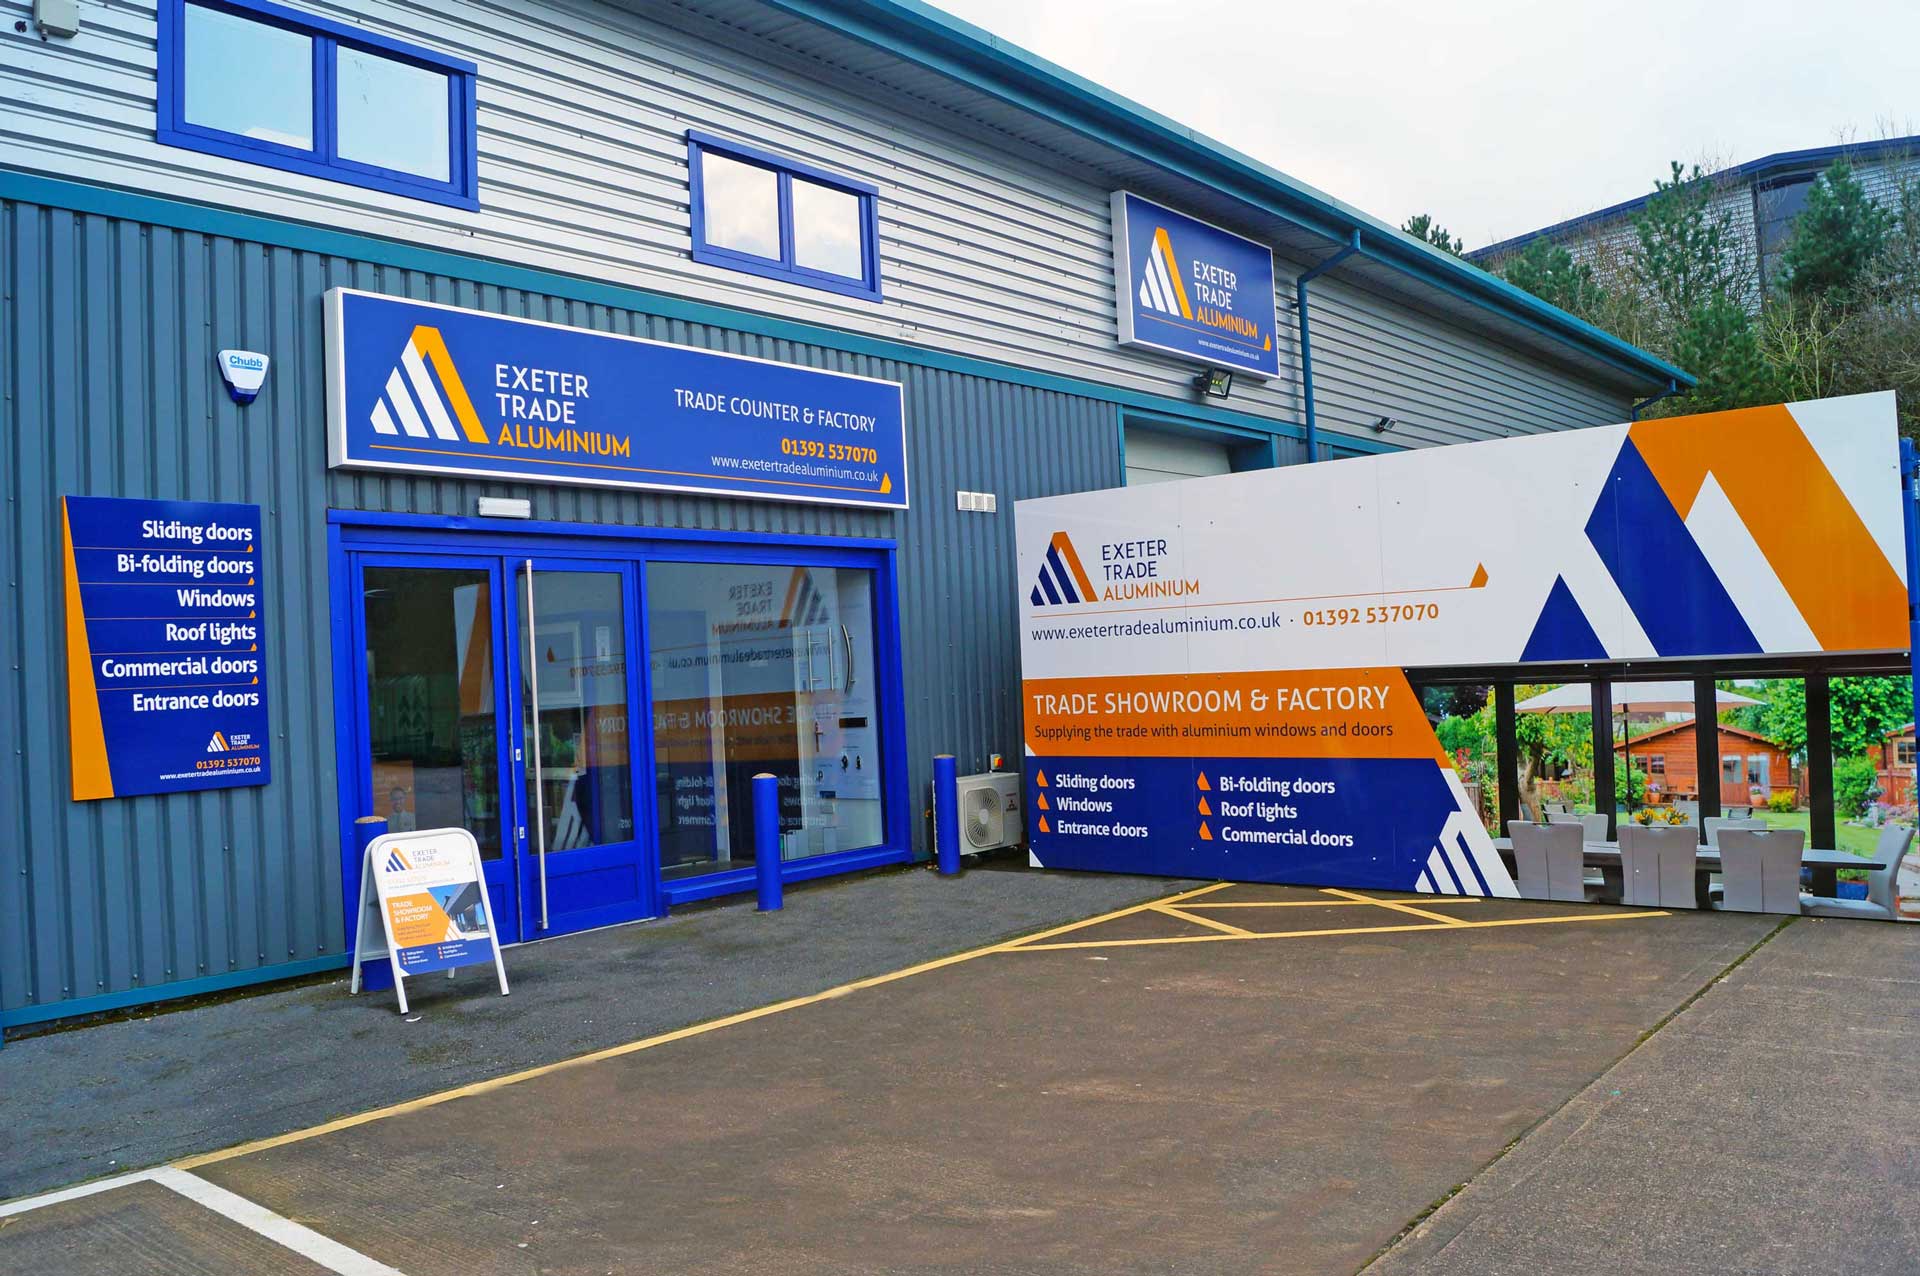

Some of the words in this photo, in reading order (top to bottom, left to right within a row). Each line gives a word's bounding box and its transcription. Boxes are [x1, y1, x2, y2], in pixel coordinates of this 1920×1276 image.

[1193, 260, 1237, 290] EXETER
[1194, 283, 1232, 310] TRADE
[1197, 306, 1258, 339] ALUMINIUM
[230, 355, 263, 367] Chubb
[496, 363, 590, 399] EXETER
[496, 393, 577, 425] TRADE
[673, 387, 727, 413] TRADE
[730, 395, 800, 424] COUNTER
[802, 403, 815, 425] &
[817, 405, 877, 433] FACTORY
[497, 424, 631, 458] ALUMINIUM
[781, 438, 825, 459] 01392
[827, 442, 878, 464] 537070
[711, 455, 879, 483] www.exetertradealuminium.co.uk
[142, 520, 203, 545] Sliding
[206, 523, 252, 541] doors
[1102, 538, 1168, 561] EXETER
[117, 554, 204, 578] Bi-folding
[207, 556, 254, 574] doors
[1104, 561, 1158, 581] TRADE
[177, 589, 255, 607] Windows
[1104, 579, 1200, 602] ALUMINIUM
[1032, 612, 1281, 641] www.exetertradealuminium.co.uk
[1303, 608, 1361, 627] 01392
[1366, 603, 1440, 624] 537070
[166, 623, 207, 641] Roof
[210, 623, 256, 644] lights
[101, 657, 208, 678] Commercial
[211, 658, 258, 675] doors
[133, 692, 209, 712] Entrance
[212, 690, 259, 707] doors
[1033, 693, 1098, 716] TRADE
[1104, 689, 1243, 715] SHOWROOM
[1250, 690, 1269, 712] &
[1277, 686, 1390, 712] FACTORY
[1035, 724, 1092, 741] Supplying
[1094, 724, 1114, 738] the
[1116, 723, 1148, 738] trade
[1151, 723, 1179, 738] with
[1182, 723, 1252, 738] aluminium
[1254, 722, 1317, 737] windows
[1320, 722, 1348, 737] and
[1351, 721, 1393, 737] doors
[160, 766, 261, 780] www.exetertradealuminium.co.uk
[196, 760, 225, 769] 01392
[227, 757, 260, 767] 537070
[1055, 774, 1098, 792] Sliding
[1100, 774, 1136, 789] doors
[1220, 776, 1291, 797] Bi-folding
[1293, 778, 1336, 794] doors
[1056, 796, 1113, 813] Windows
[1221, 801, 1254, 818] Roof
[1257, 801, 1298, 821] lights
[1057, 820, 1110, 836] Entrance
[1112, 822, 1148, 838] doors
[1222, 827, 1308, 846] Commercial
[1310, 830, 1354, 847] doors
